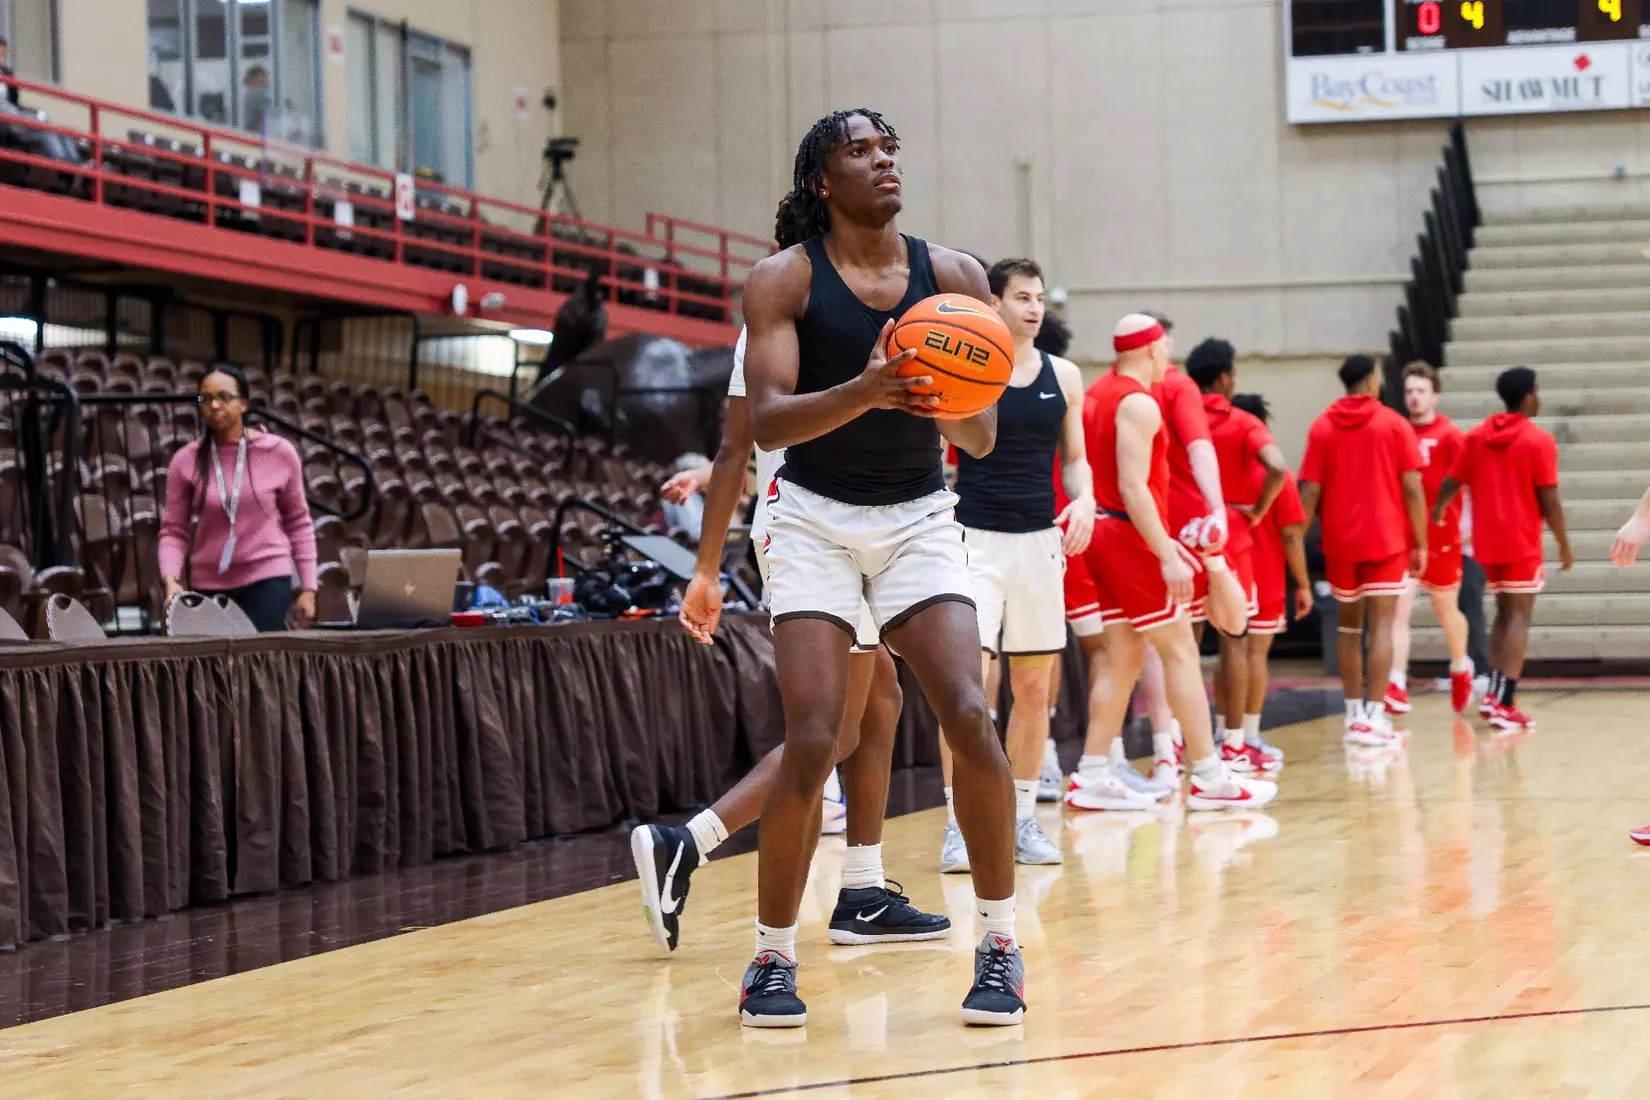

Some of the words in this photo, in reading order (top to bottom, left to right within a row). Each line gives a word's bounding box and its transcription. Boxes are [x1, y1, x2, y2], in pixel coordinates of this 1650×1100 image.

[1417, 1, 1441, 35] 0
[1460, 1, 1485, 30] 4
[1481, 75, 1605, 102] SHAWMUT
[925, 329, 990, 367] ELITE
